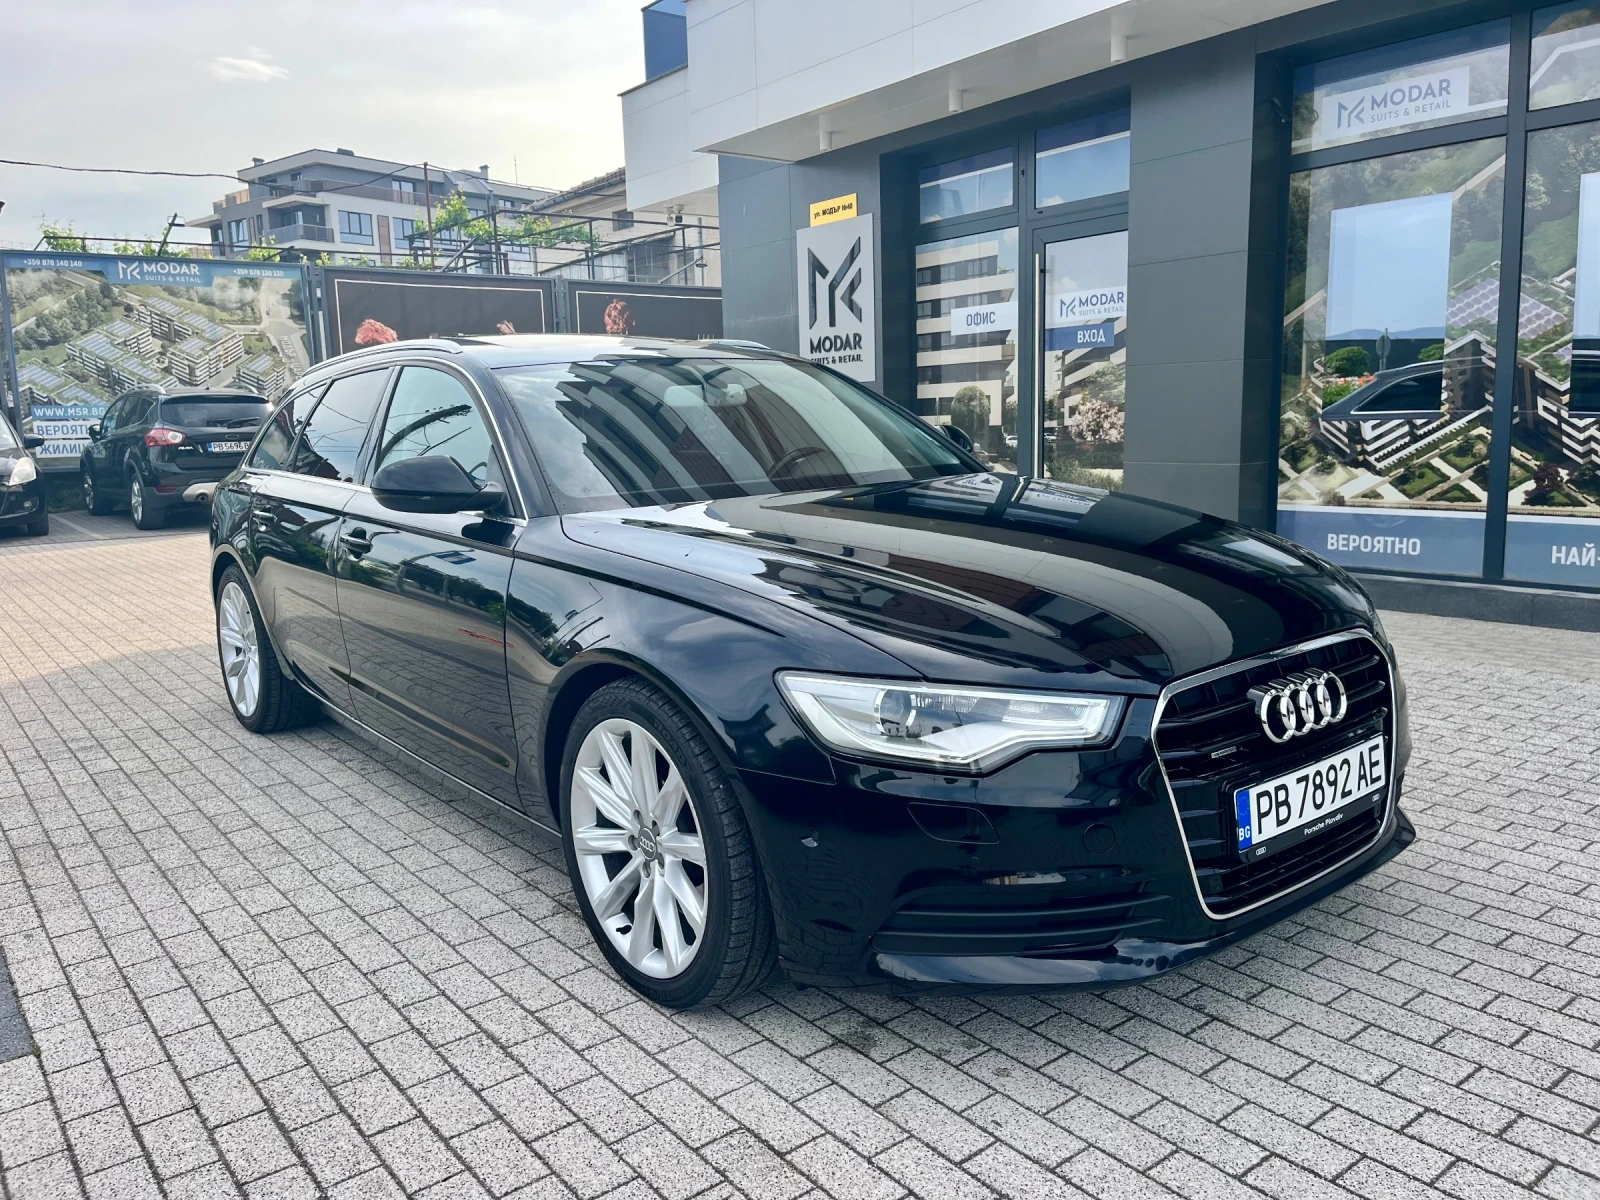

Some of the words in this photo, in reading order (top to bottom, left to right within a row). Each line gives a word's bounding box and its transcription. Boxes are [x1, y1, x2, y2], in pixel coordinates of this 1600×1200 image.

[1370, 78, 1452, 111] MODAR
[1370, 109, 1400, 123] SUITS
[1403, 106, 1410, 116] &
[1414, 99, 1452, 115] RETAIL
[822, 205, 841, 216] МОДЪР
[56, 259, 69, 267] 140
[143, 261, 200, 275] MODAR
[1079, 291, 1125, 308] MODAR
[1104, 306, 1125, 314] RETAIL
[966, 311, 996, 327] ОФИС
[809, 332, 863, 354] MODAR
[1077, 328, 1106, 343] ВХОД
[832, 356, 837, 364] &
[838, 354, 864, 363] RETAIL
[34, 407, 105, 417] WWW.MSR.BG
[37, 424, 89, 436] ВЕРОЯТ
[1327, 533, 1421, 555] ВЕРОЯТНО
[1256, 783, 1292, 835] PB
[1295, 757, 1353, 819] 7892
[1357, 743, 1382, 792] AE
[1304, 822, 1325, 836] Porsche
[1325, 813, 1344, 826] Plovdiv
[1238, 825, 1251, 841] BG
